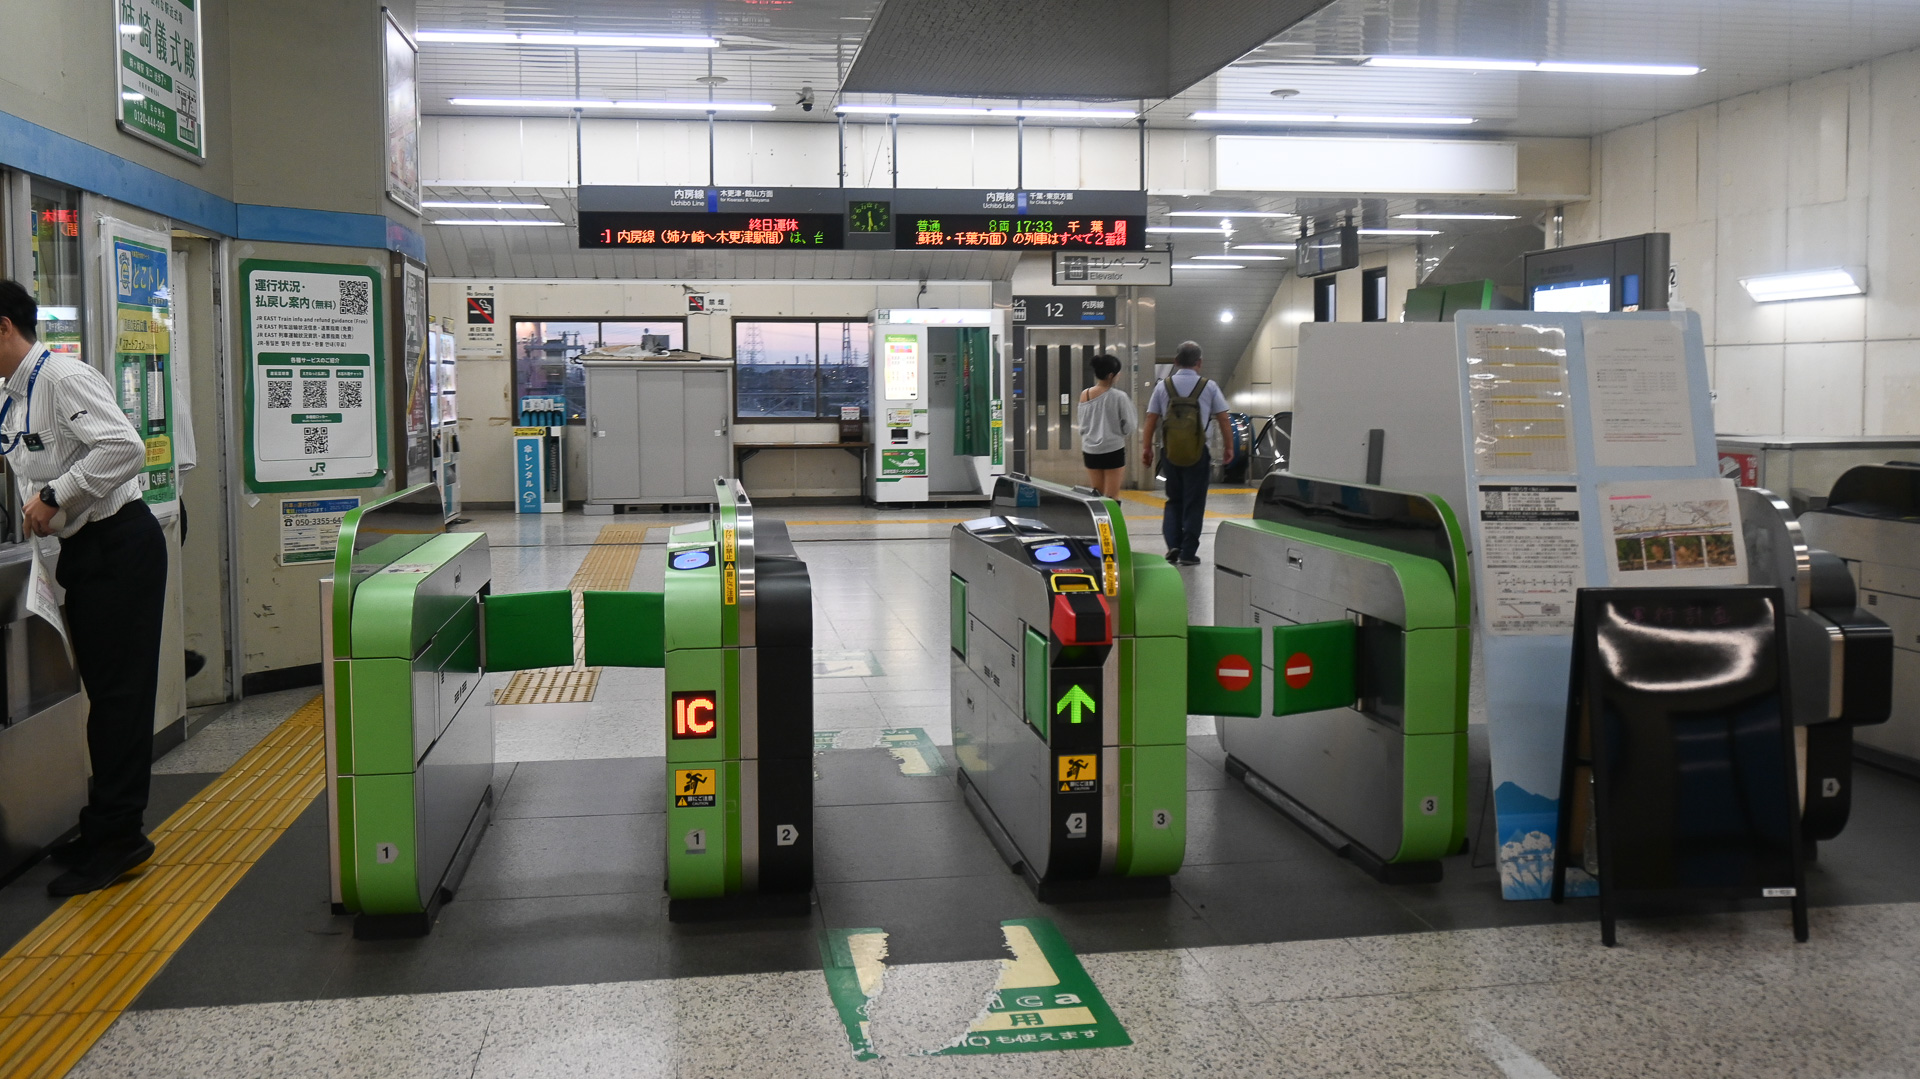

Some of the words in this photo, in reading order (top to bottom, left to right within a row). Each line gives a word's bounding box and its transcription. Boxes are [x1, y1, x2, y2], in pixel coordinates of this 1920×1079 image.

[134, 109, 166, 134] 0120-444-999
[674, 189, 704, 199] 内房線
[986, 192, 1014, 202] 内房線
[1029, 192, 1073, 200] 千葉・東京方面
[748, 218, 798, 231] 終日運休
[917, 220, 940, 232] 普通
[1016, 220, 1053, 232] 17:33
[1090, 256, 1161, 269] エレベーター
[132, 264, 166, 291] どこトレ
[1090, 272, 1123, 280] Elevator
[255, 279, 305, 293] 運行状況・
[1082, 300, 1104, 309] 内房線
[310, 462, 326, 472] JR
[523, 444, 533, 488] 傘レンタル
[157, 472, 167, 485] 検索
[677, 698, 714, 733] IC
[1825, 782, 1834, 794] 4
[1426, 800, 1434, 812] 3
[1074, 817, 1083, 830] 2
[1156, 813, 1165, 825] 3
[693, 833, 701, 845] 1
[781, 829, 790, 841] 2
[382, 846, 389, 859] 1
[1010, 1012, 1044, 1026] 用
